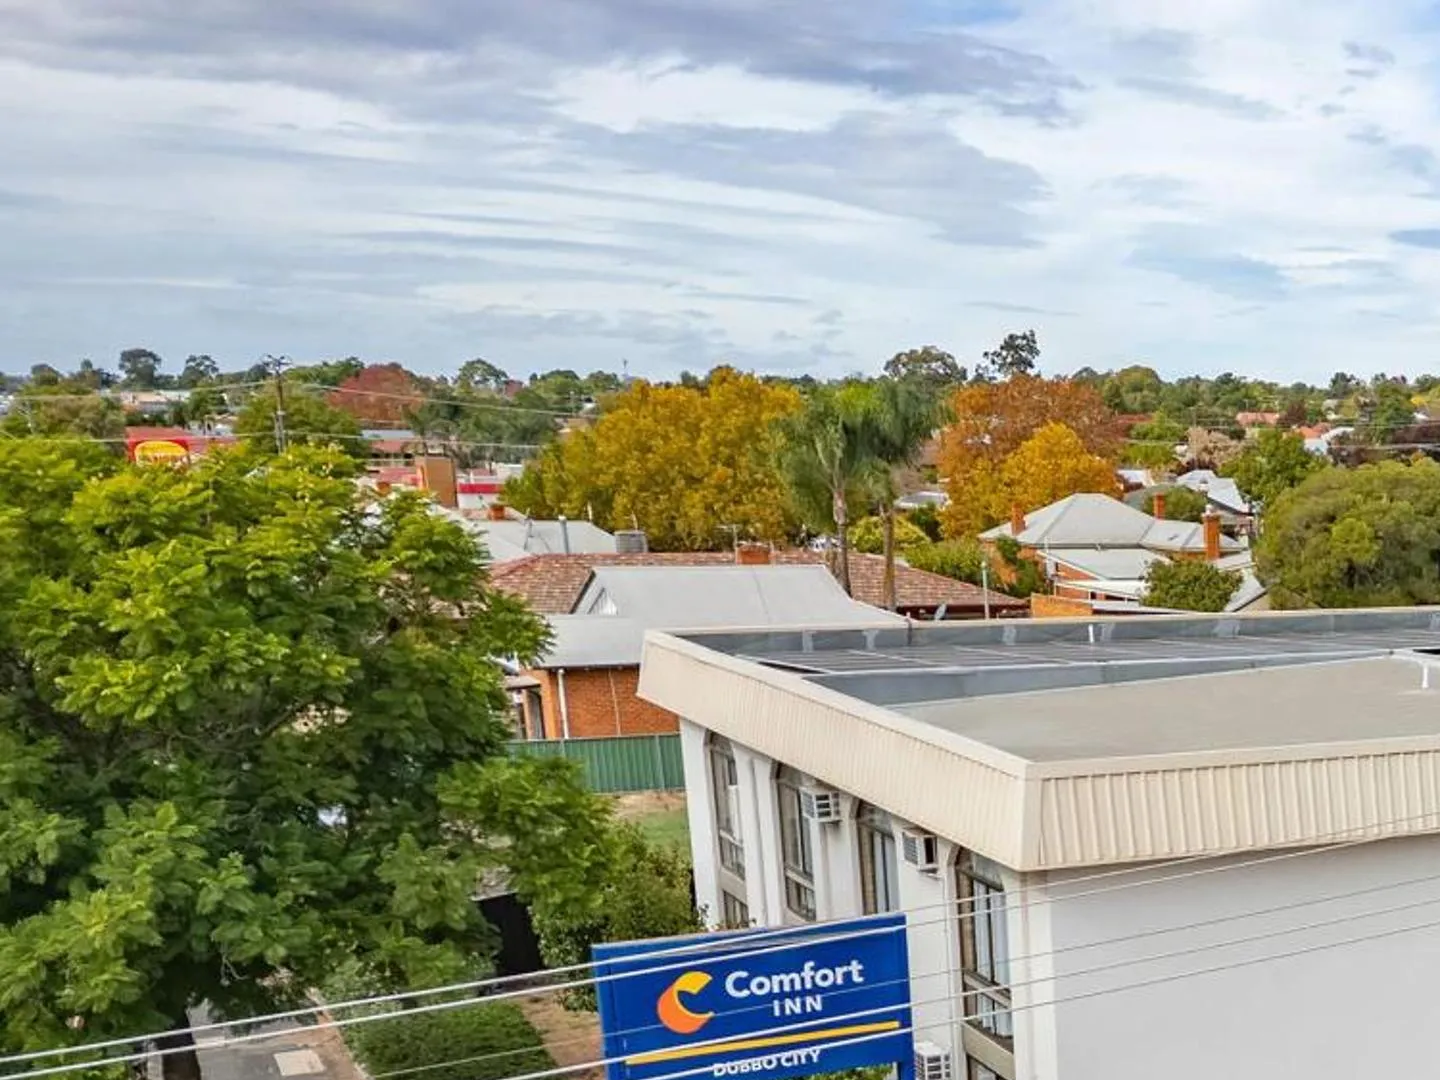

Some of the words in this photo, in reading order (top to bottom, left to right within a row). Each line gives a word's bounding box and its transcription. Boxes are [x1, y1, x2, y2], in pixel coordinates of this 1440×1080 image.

[725, 960, 864, 998] Comfort
[773, 995, 822, 1016] INN
[713, 1056, 778, 1077] DUBBO
[780, 1048, 821, 1067] CITY
